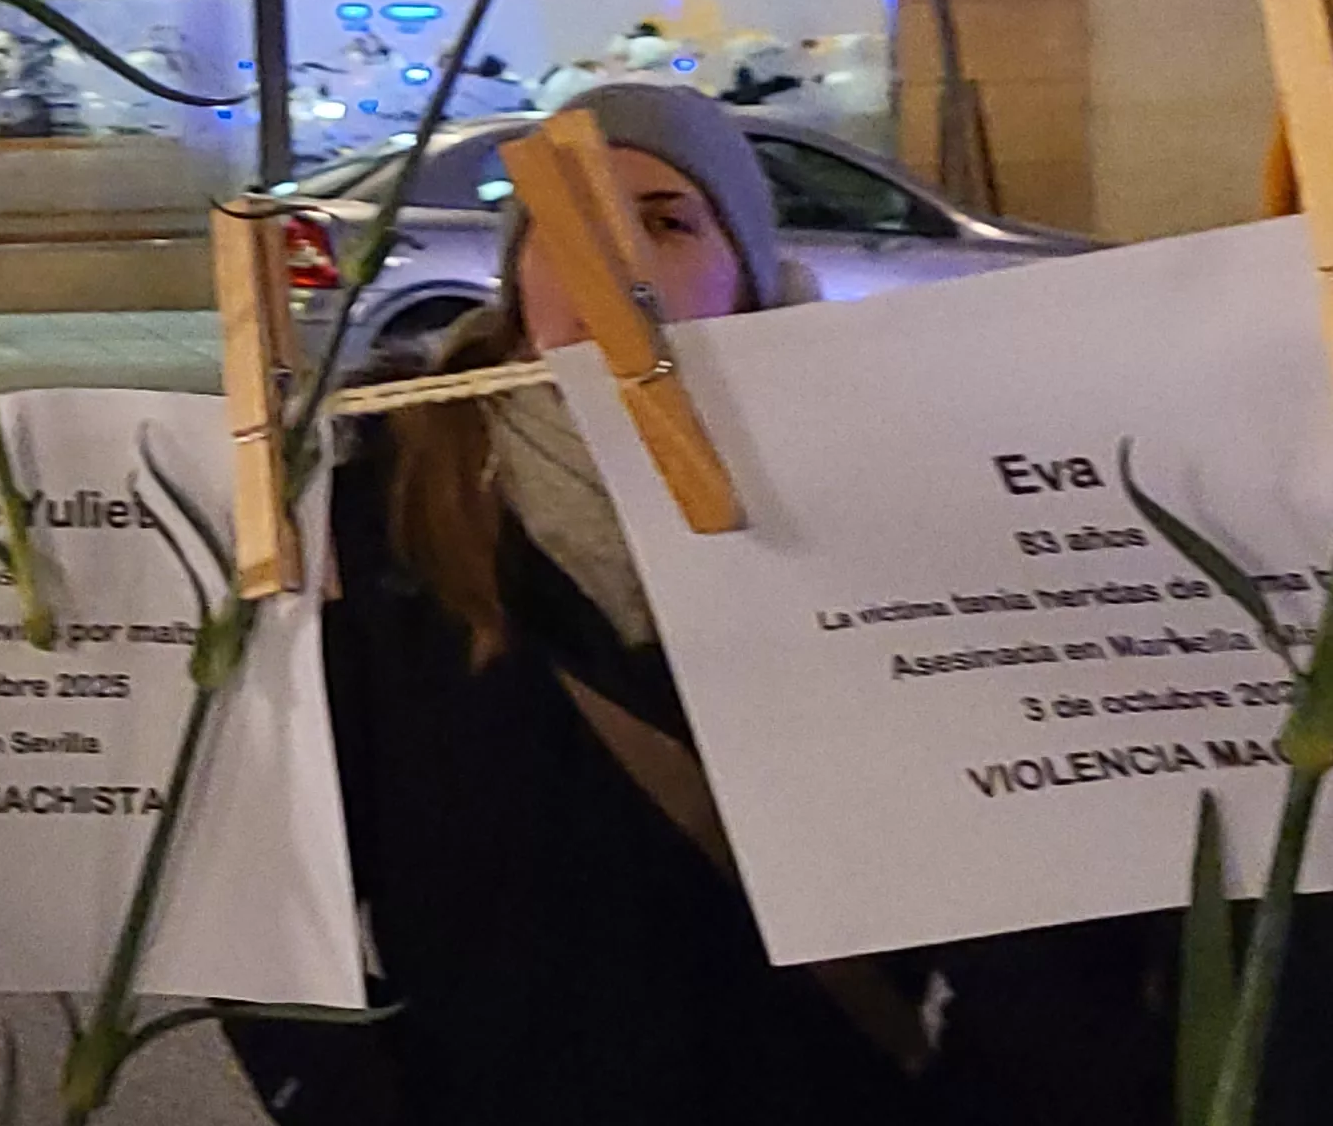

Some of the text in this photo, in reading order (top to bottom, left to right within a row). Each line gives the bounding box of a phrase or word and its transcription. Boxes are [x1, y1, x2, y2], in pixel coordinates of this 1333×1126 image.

[992, 451, 1106, 496] Eva
[1063, 524, 1150, 553] años
[1165, 574, 1212, 602] de
[890, 637, 1059, 680] Asesinada
[1064, 638, 1108, 662] en
[55, 672, 132, 701] 2025
[1019, 695, 1045, 723] 3
[1050, 694, 1098, 719] de
[1100, 684, 1232, 716] octubre
[965, 737, 1205, 799] VIOLENCIA
